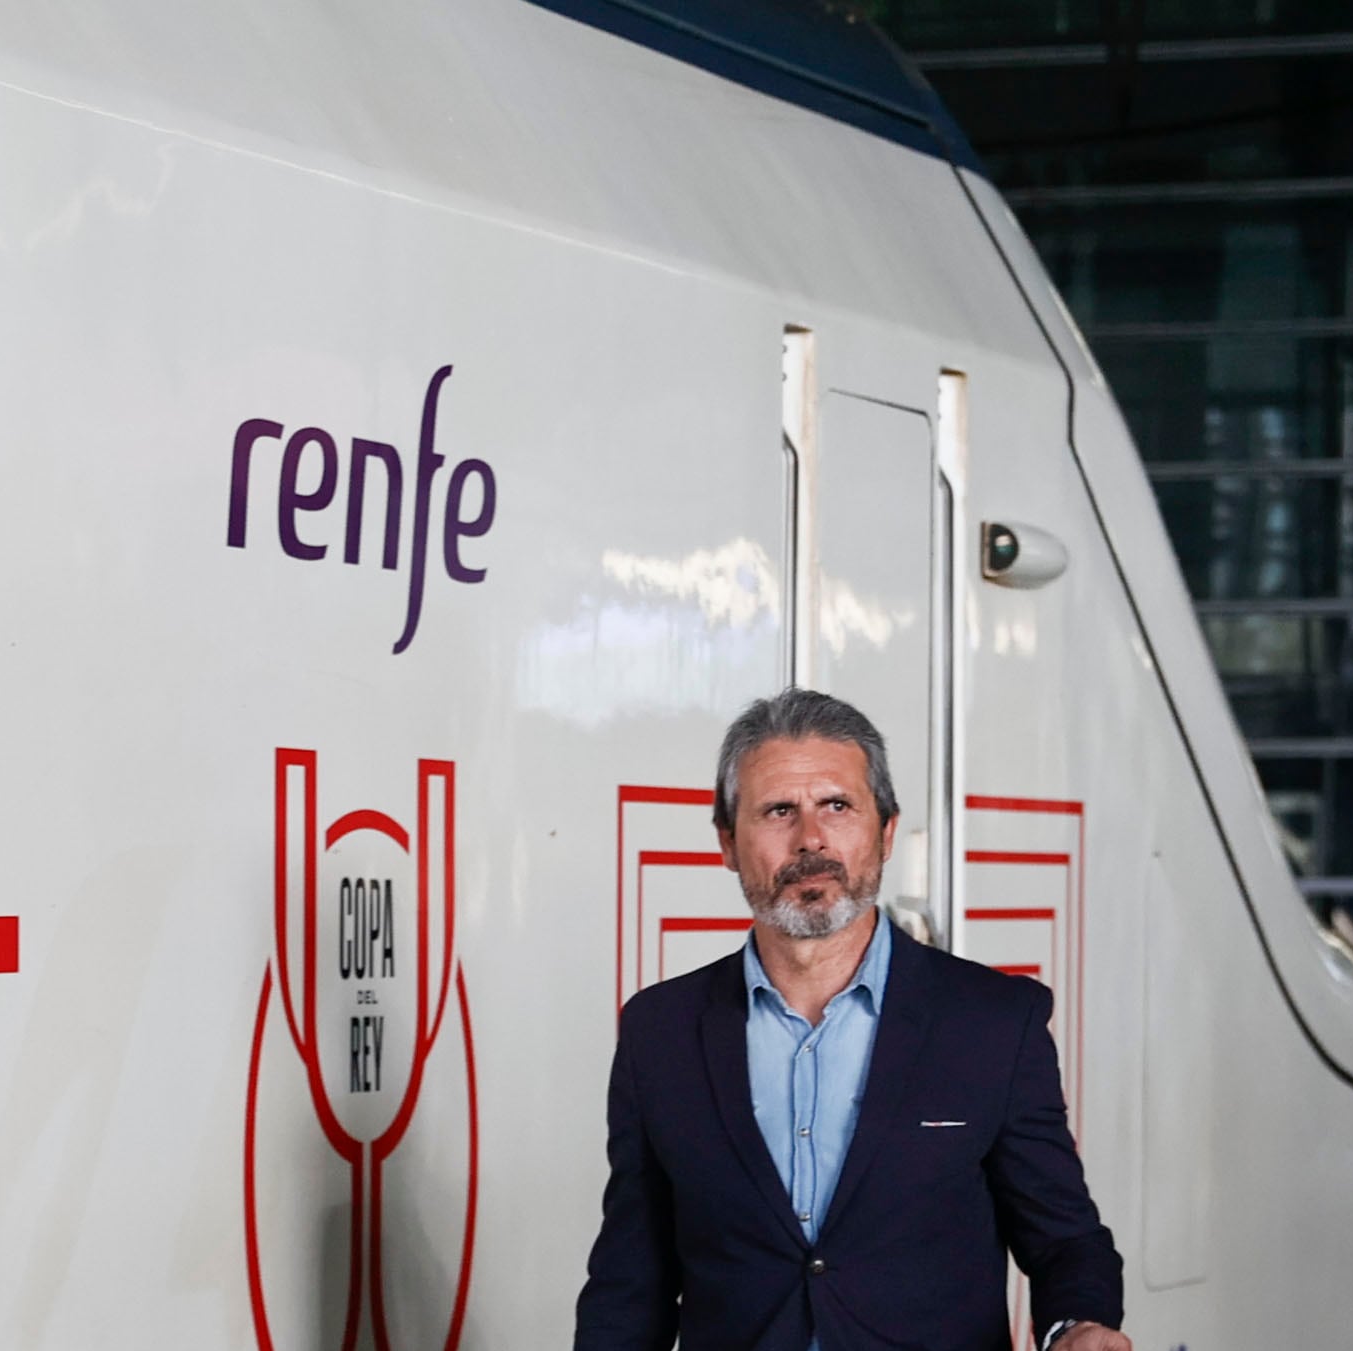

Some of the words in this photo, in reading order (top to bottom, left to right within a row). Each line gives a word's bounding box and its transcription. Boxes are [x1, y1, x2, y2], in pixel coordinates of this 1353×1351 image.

[227, 364, 496, 655] renfe
[340, 877, 394, 980] COPA
[357, 990, 379, 1004] DEL
[350, 1016, 384, 1093] REY
